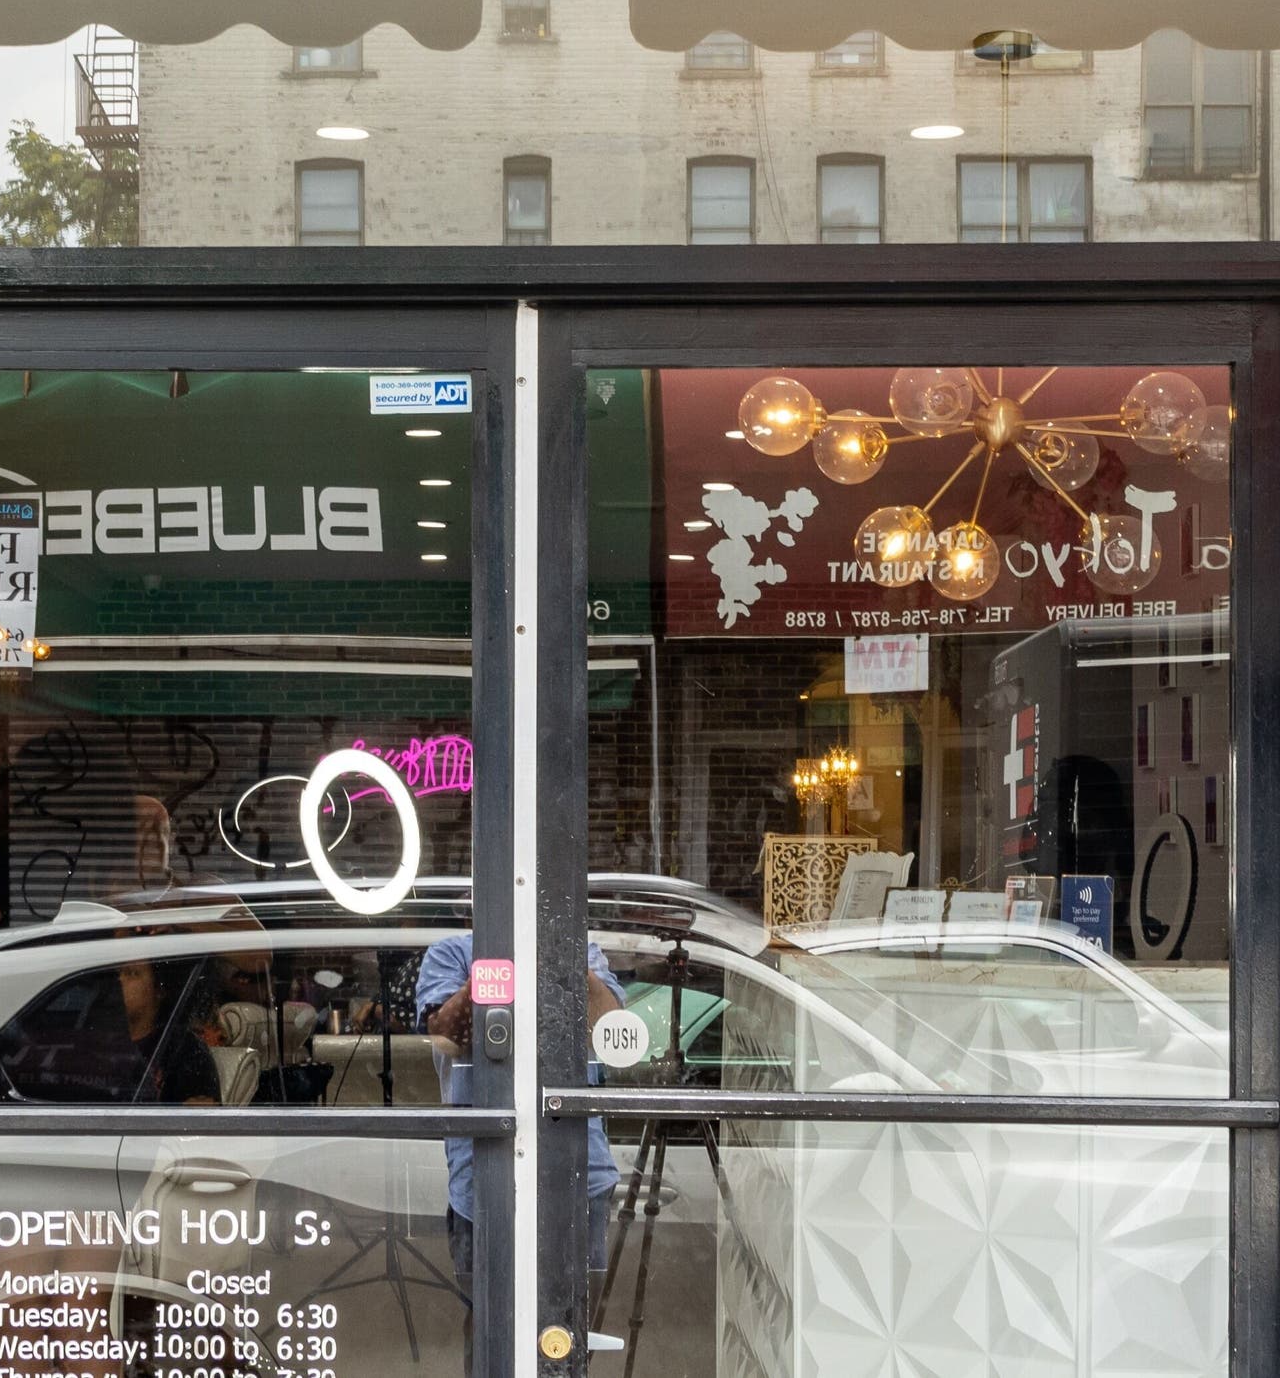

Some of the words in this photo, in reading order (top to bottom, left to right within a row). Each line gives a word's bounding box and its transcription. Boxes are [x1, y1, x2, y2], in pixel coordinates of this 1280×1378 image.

[376, 394, 417, 402] secured
[420, 393, 431, 404] by
[436, 385, 467, 401] ADT
[475, 967, 511, 980] RING
[478, 984, 507, 998] BELL
[603, 1027, 638, 1049] PUSH
[186, 1270, 271, 1295] Closed
[155, 1304, 226, 1329] 10:00
[232, 1307, 259, 1328] to
[277, 1304, 337, 1329] 6:30
[154, 1336, 226, 1361] 10:00
[232, 1339, 259, 1361] to
[277, 1336, 337, 1361] 6:30
